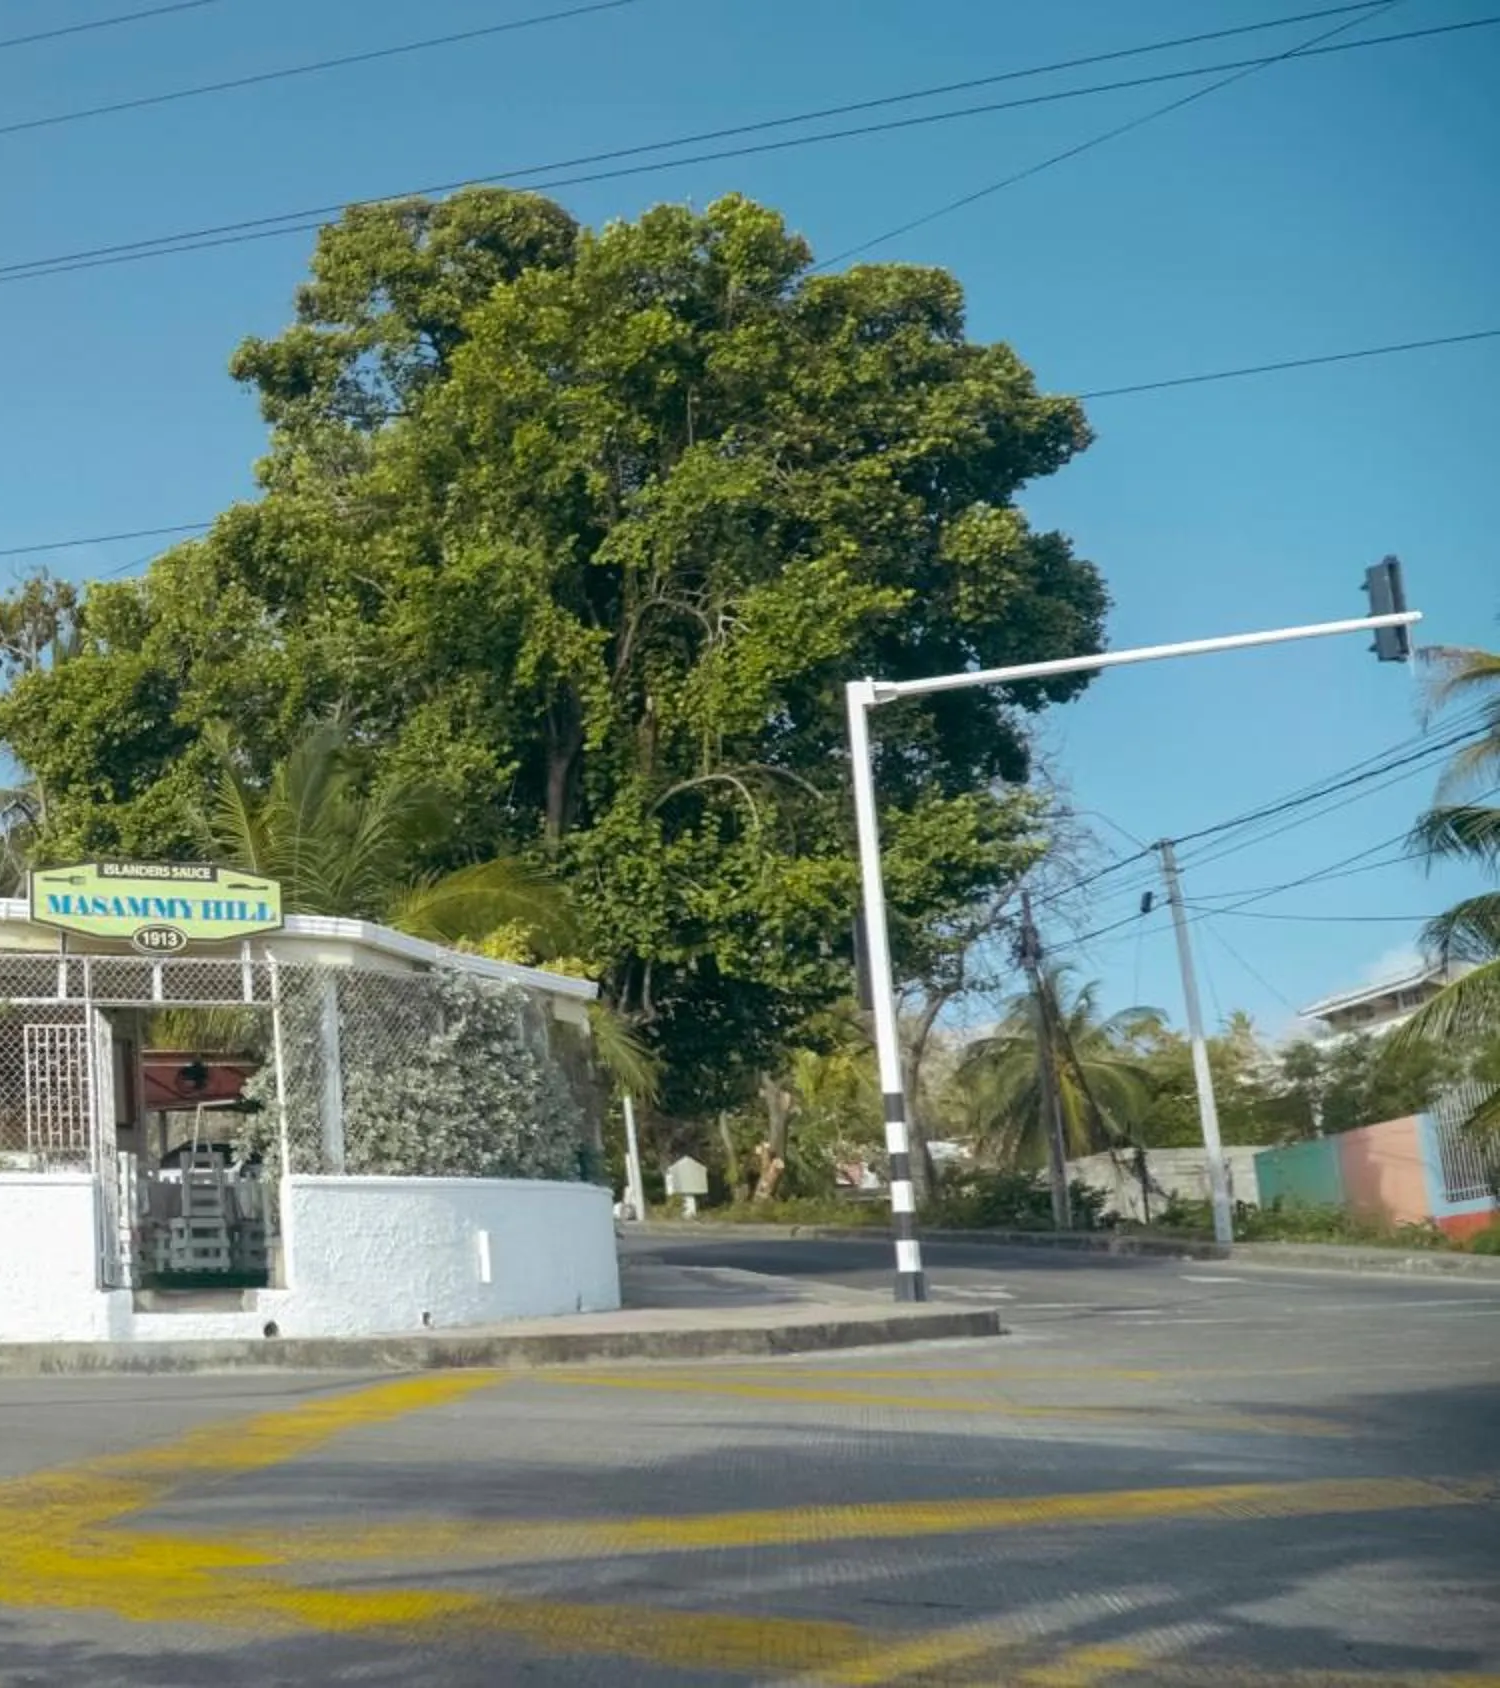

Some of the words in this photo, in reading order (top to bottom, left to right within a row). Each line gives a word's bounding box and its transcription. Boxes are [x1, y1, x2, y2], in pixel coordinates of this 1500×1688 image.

[103, 864, 170, 878] ISLANDERS
[172, 864, 211, 879] SAUCE
[47, 894, 193, 920] MASAMMY
[202, 899, 277, 922] HILL
[141, 931, 177, 947] 1913
